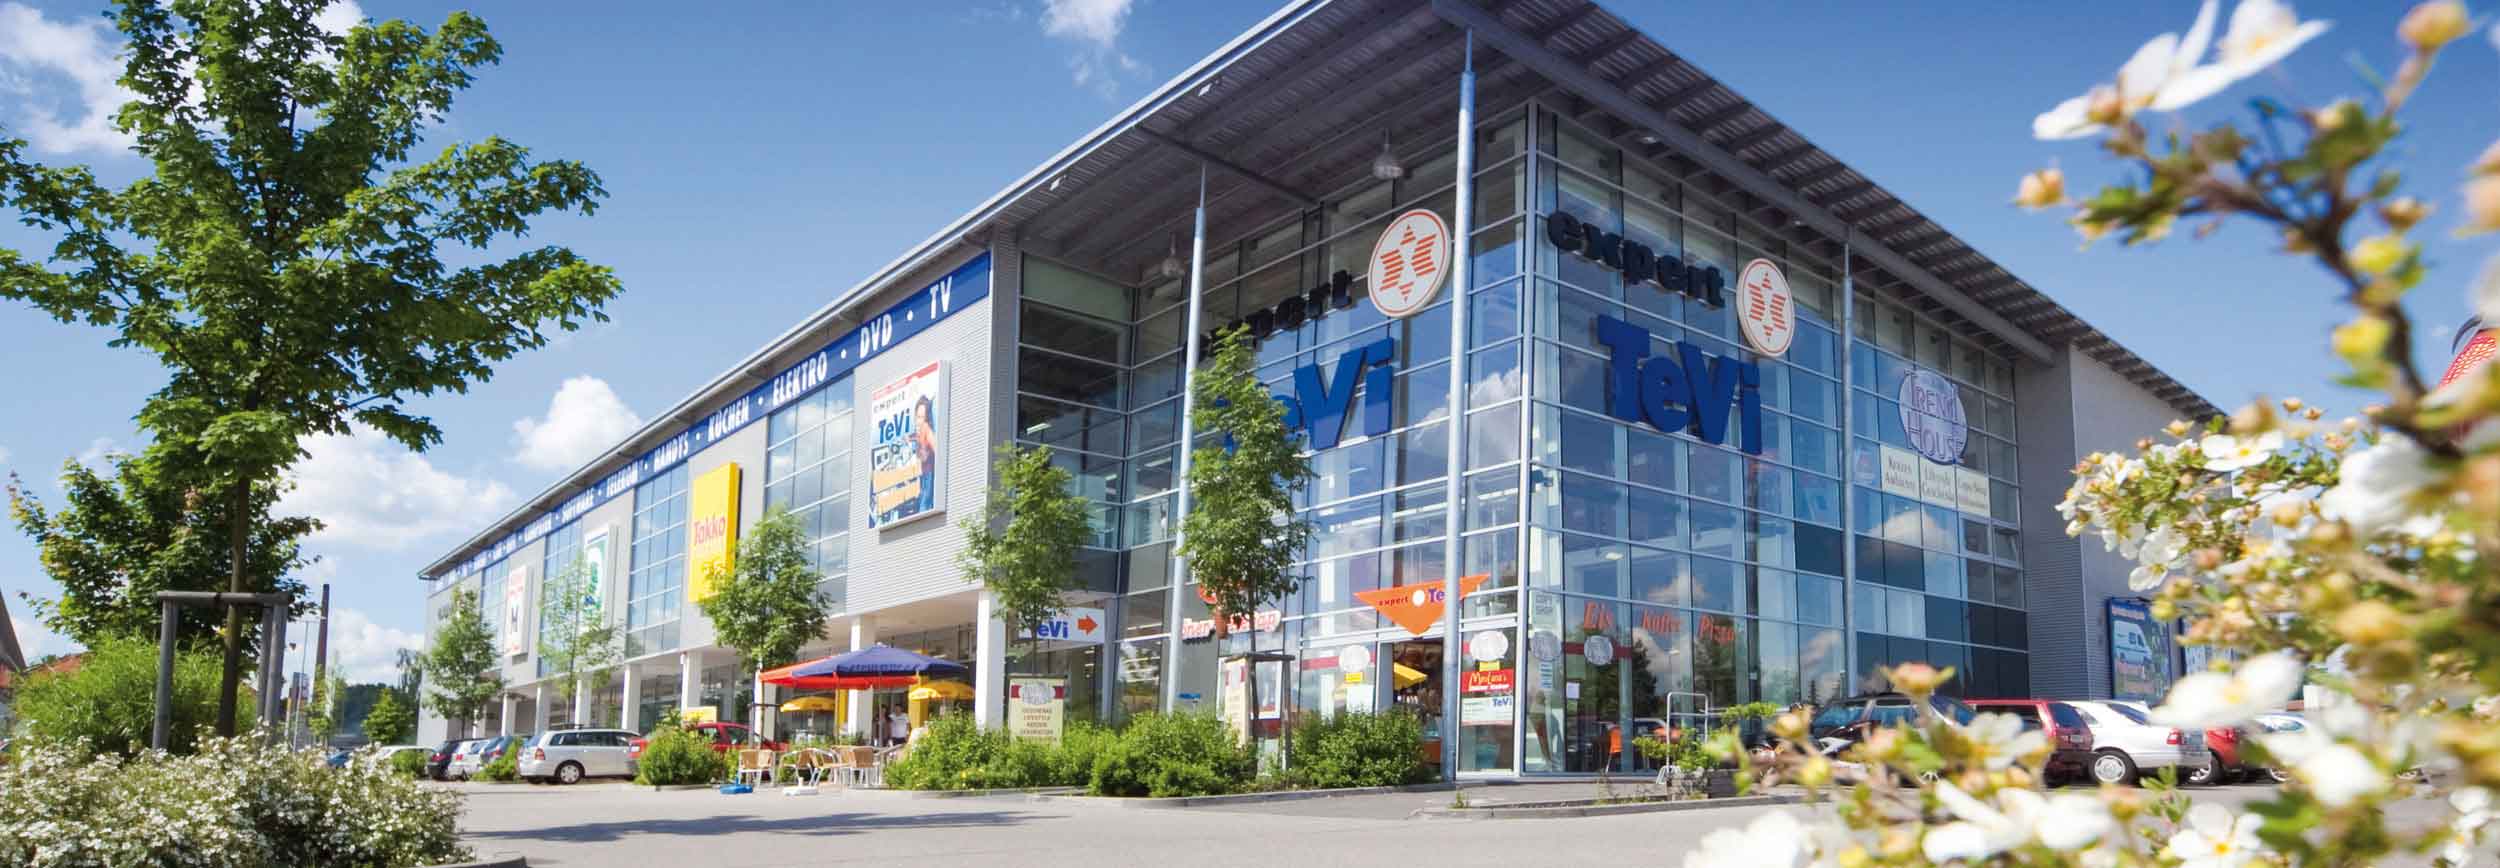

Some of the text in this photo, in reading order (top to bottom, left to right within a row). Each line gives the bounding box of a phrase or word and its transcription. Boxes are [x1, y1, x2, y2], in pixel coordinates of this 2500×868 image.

[1548, 211, 1725, 309] expert
[653, 431, 689, 472] HANDYS
[772, 351, 828, 400] ELEKTRO
[859, 313, 893, 358] DVD
[929, 276, 953, 319] TV
[1597, 313, 1762, 455] TeVi
[879, 408, 911, 444] TeVi
[1428, 588, 1445, 603] Te
[1036, 620, 1069, 639] eVi
